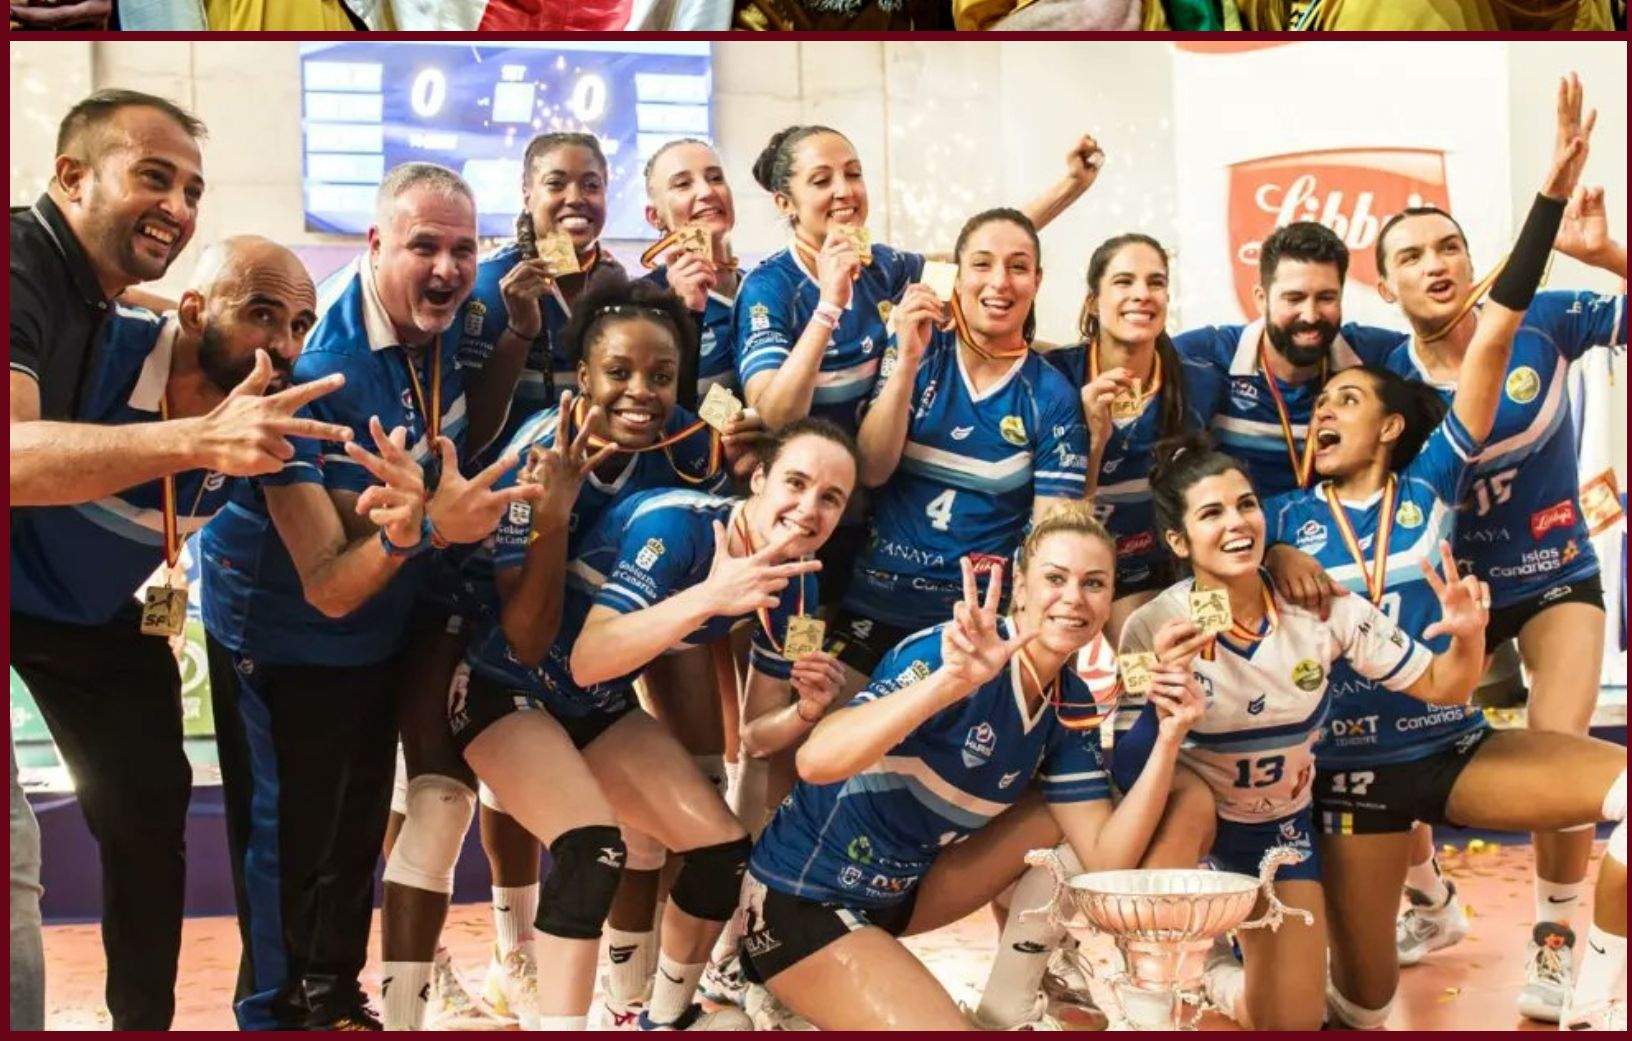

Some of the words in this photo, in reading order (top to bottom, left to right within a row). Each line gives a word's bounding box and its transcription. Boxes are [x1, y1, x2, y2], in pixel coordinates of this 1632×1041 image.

[411, 68, 446, 118] 0
[572, 73, 607, 122] 0
[926, 489, 957, 532] 4
[1127, 675, 1150, 688] SF
[1331, 715, 1380, 737] DXT
[1234, 755, 1286, 789] 13
[1331, 770, 1375, 796] 17
